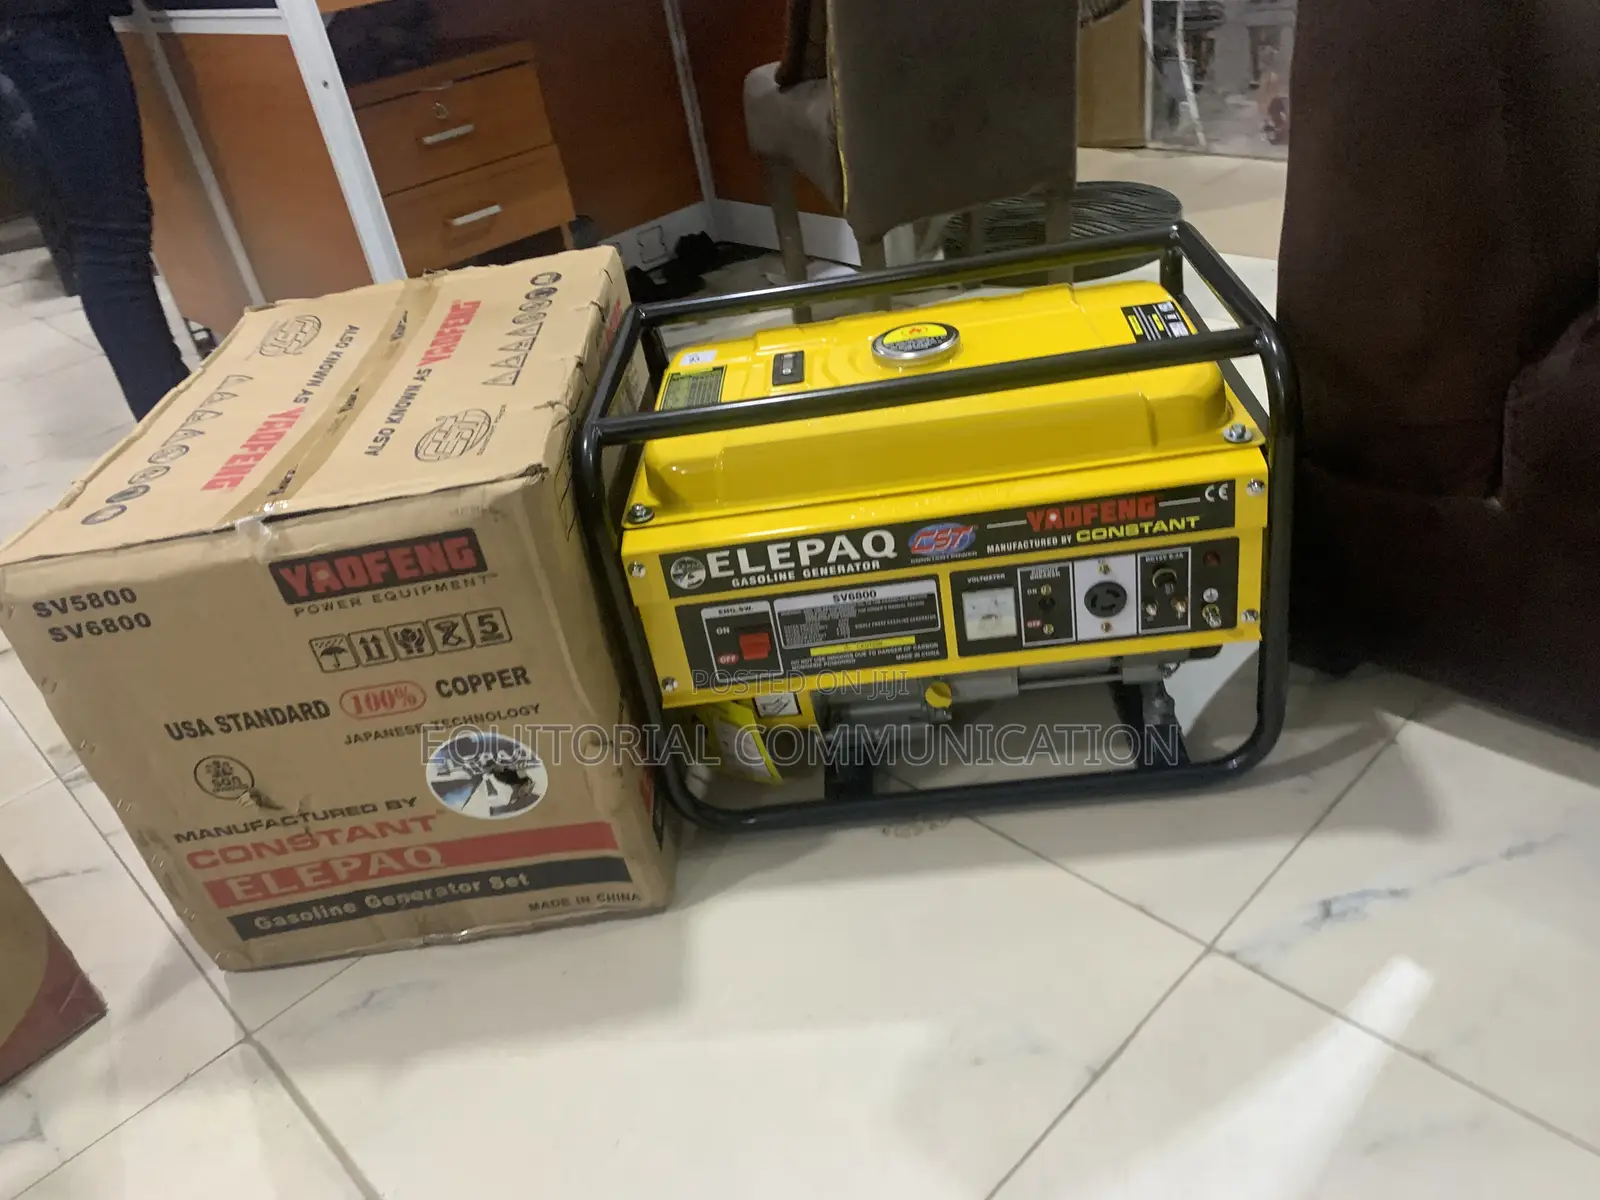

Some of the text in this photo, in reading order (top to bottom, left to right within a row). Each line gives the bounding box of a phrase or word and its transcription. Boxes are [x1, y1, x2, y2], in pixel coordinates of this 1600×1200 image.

[338, 324, 360, 350] ALSO
[306, 351, 343, 387] KNOWN
[293, 388, 314, 404] AS
[364, 368, 432, 456] ALSO KNOWN AS
[201, 406, 305, 493] YAOFENG
[1204, 483, 1229, 502] CE
[1026, 495, 1156, 533] YAOFENG
[706, 529, 898, 579] ELEPAQ
[987, 516, 1200, 554] MANUFACTURED BY CONSTANT
[278, 535, 477, 597] YAOFENG
[731, 559, 881, 589] GASOLINE GENERATOR
[32, 587, 137, 618] SV5800
[293, 575, 490, 617] POWER EQUIPMENT
[832, 590, 877, 603] SV6800
[48, 612, 152, 642] SV6800
[716, 626, 730, 635] ON
[719, 655, 736, 665] OFF
[164, 665, 532, 741] USA STANDARD 100% COPPER
[344, 703, 541, 745] JAPANESE TECHNOLOGY
[173, 796, 418, 844] MANUFACTURED BY
[186, 814, 437, 870] CONSTANT
[225, 845, 447, 900] ELEPAQ
[253, 872, 531, 931] Gasoline Generator Set
[528, 891, 642, 913] MADE IN CHINA
